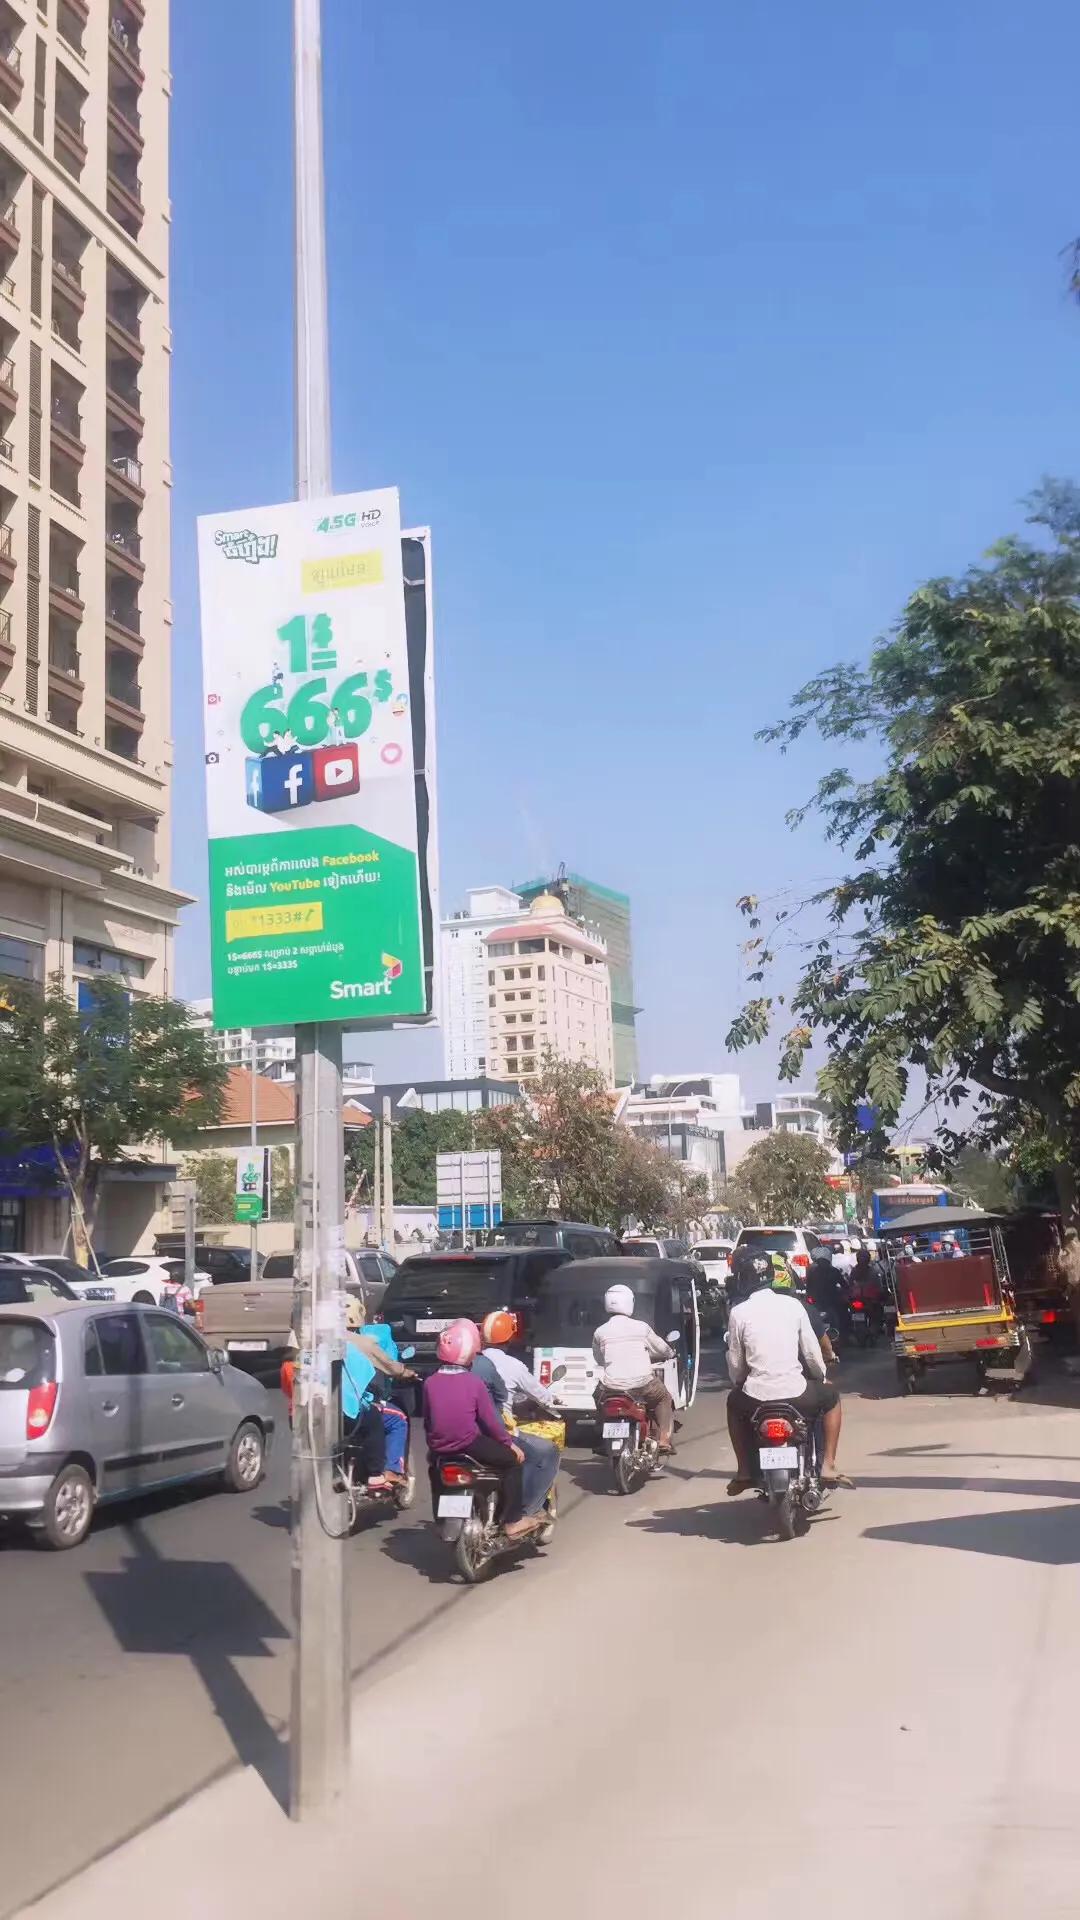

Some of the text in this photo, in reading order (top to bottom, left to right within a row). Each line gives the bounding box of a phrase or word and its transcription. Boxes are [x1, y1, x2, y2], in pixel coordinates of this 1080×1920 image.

[316, 512, 357, 533] 4.5G
[361, 509, 381, 522] HD
[322, 850, 380, 867] Facebook
[270, 878, 321, 893] YouTube
[330, 978, 392, 999] Smart
